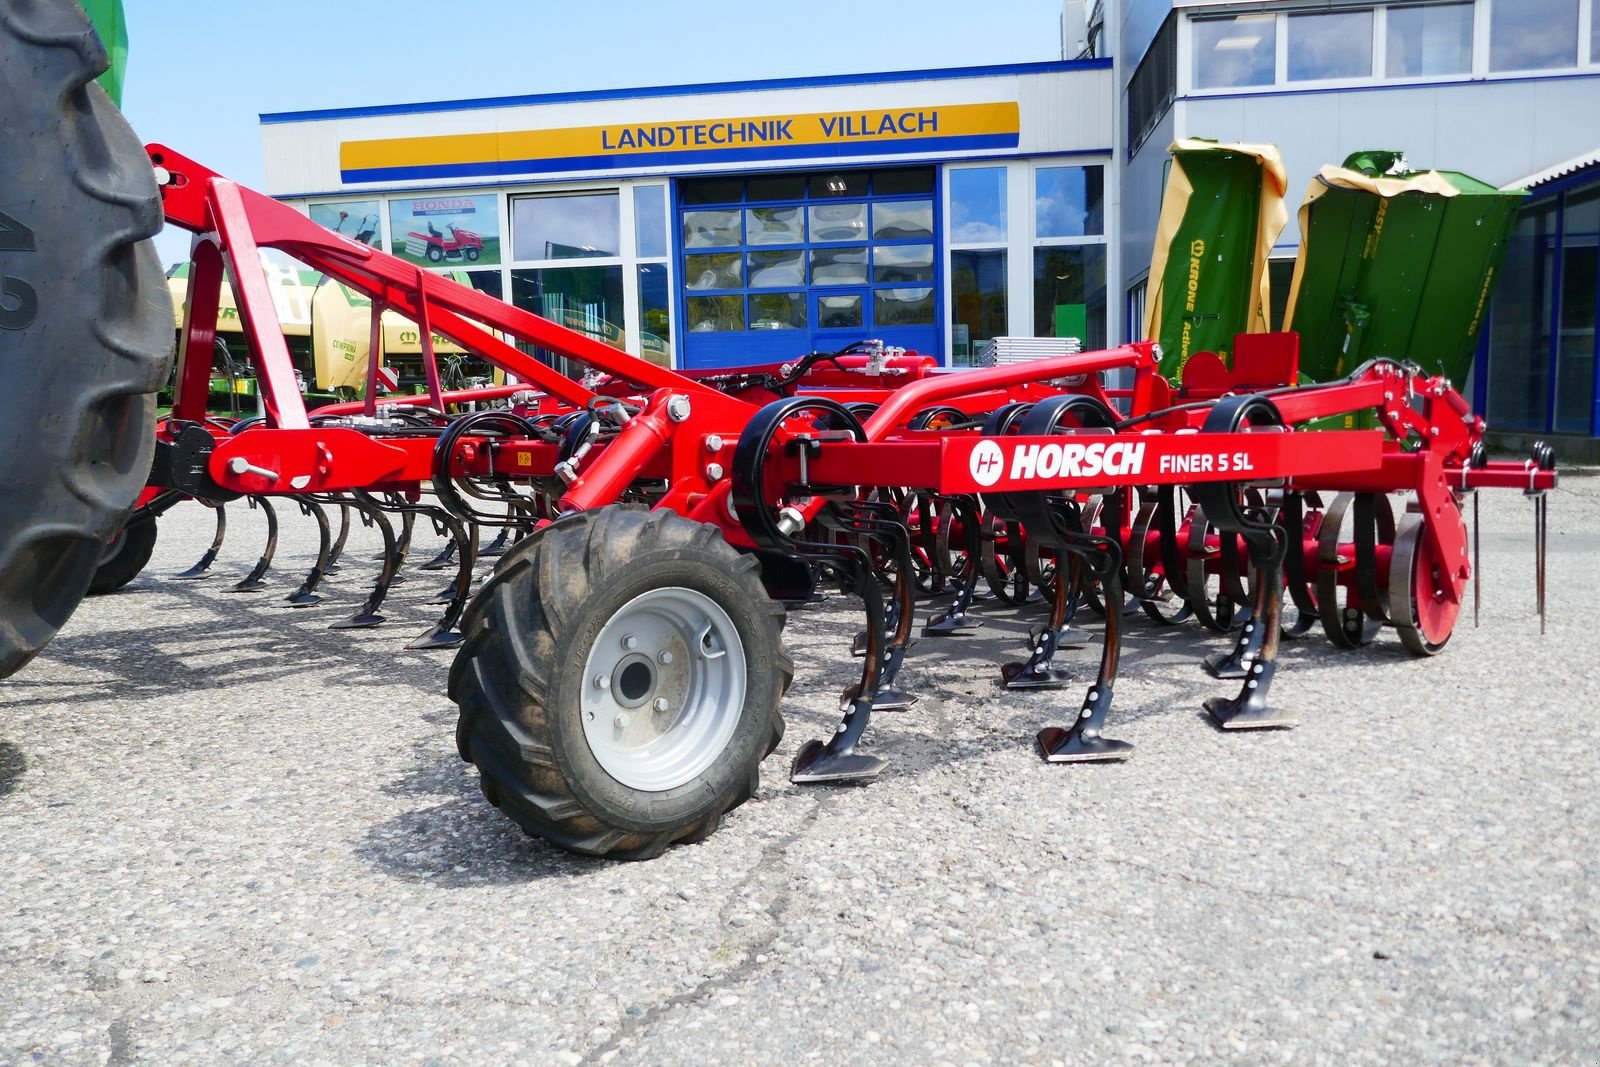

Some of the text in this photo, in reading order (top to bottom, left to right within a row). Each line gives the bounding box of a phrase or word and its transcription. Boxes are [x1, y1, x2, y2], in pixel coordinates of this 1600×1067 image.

[602, 111, 938, 150] LANDTECHNIK VILLACH
[413, 198, 476, 210] HONDA
[1186, 257, 1200, 312] KRONE
[1010, 442, 1254, 479] HORSCH FINER 5 SL
